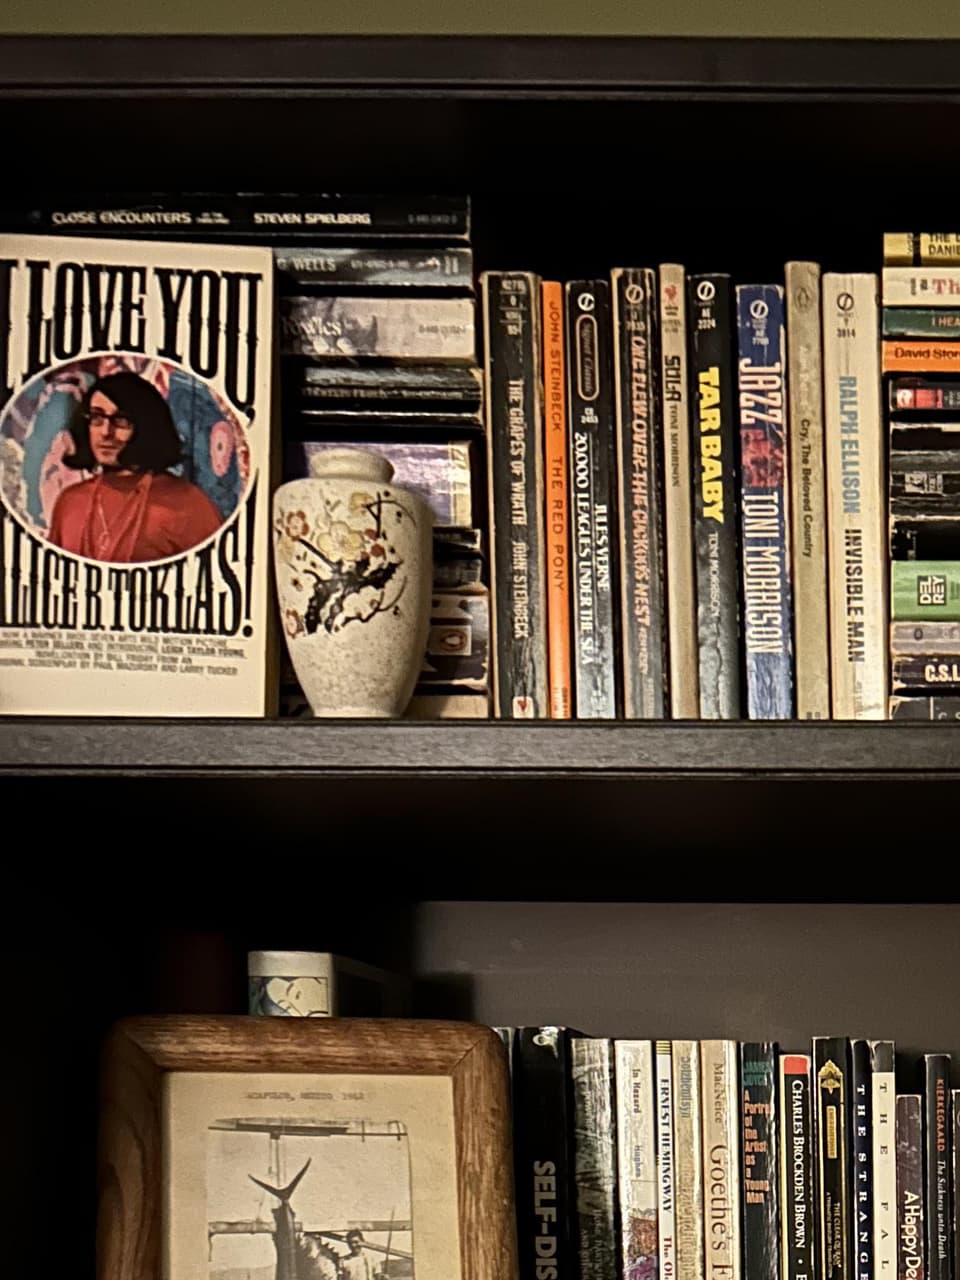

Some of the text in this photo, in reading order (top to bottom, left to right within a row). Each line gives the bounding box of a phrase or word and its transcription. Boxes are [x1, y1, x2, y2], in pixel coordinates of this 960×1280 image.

[52, 211, 191, 225] CLOSE ENCOUNTERS
[254, 213, 371, 226] STEVEN SPIELBERG
[26, 261, 148, 381] LOVE
[548, 301, 563, 432] JOHN STEINBECK
[894, 346, 930, 360] David
[698, 366, 724, 524] TAR BABY
[551, 456, 566, 591] THE RED PONY
[739, 359, 784, 655] JAZZ TONI MORRISON
[839, 376, 866, 663] RALPH ELLISON INVISIBLE MAN
[511, 541, 531, 639] JOHN STEINBECK
[708, 532, 720, 617] TONI MORRISON
[660, 1077, 673, 1214] ERNEST HEMINGWAY
[791, 1079, 809, 1248] CHARLES BROCKDEN BROWN
[935, 1079, 946, 1152] KIERKEGAARD
[662, 1236, 674, 1258] The
